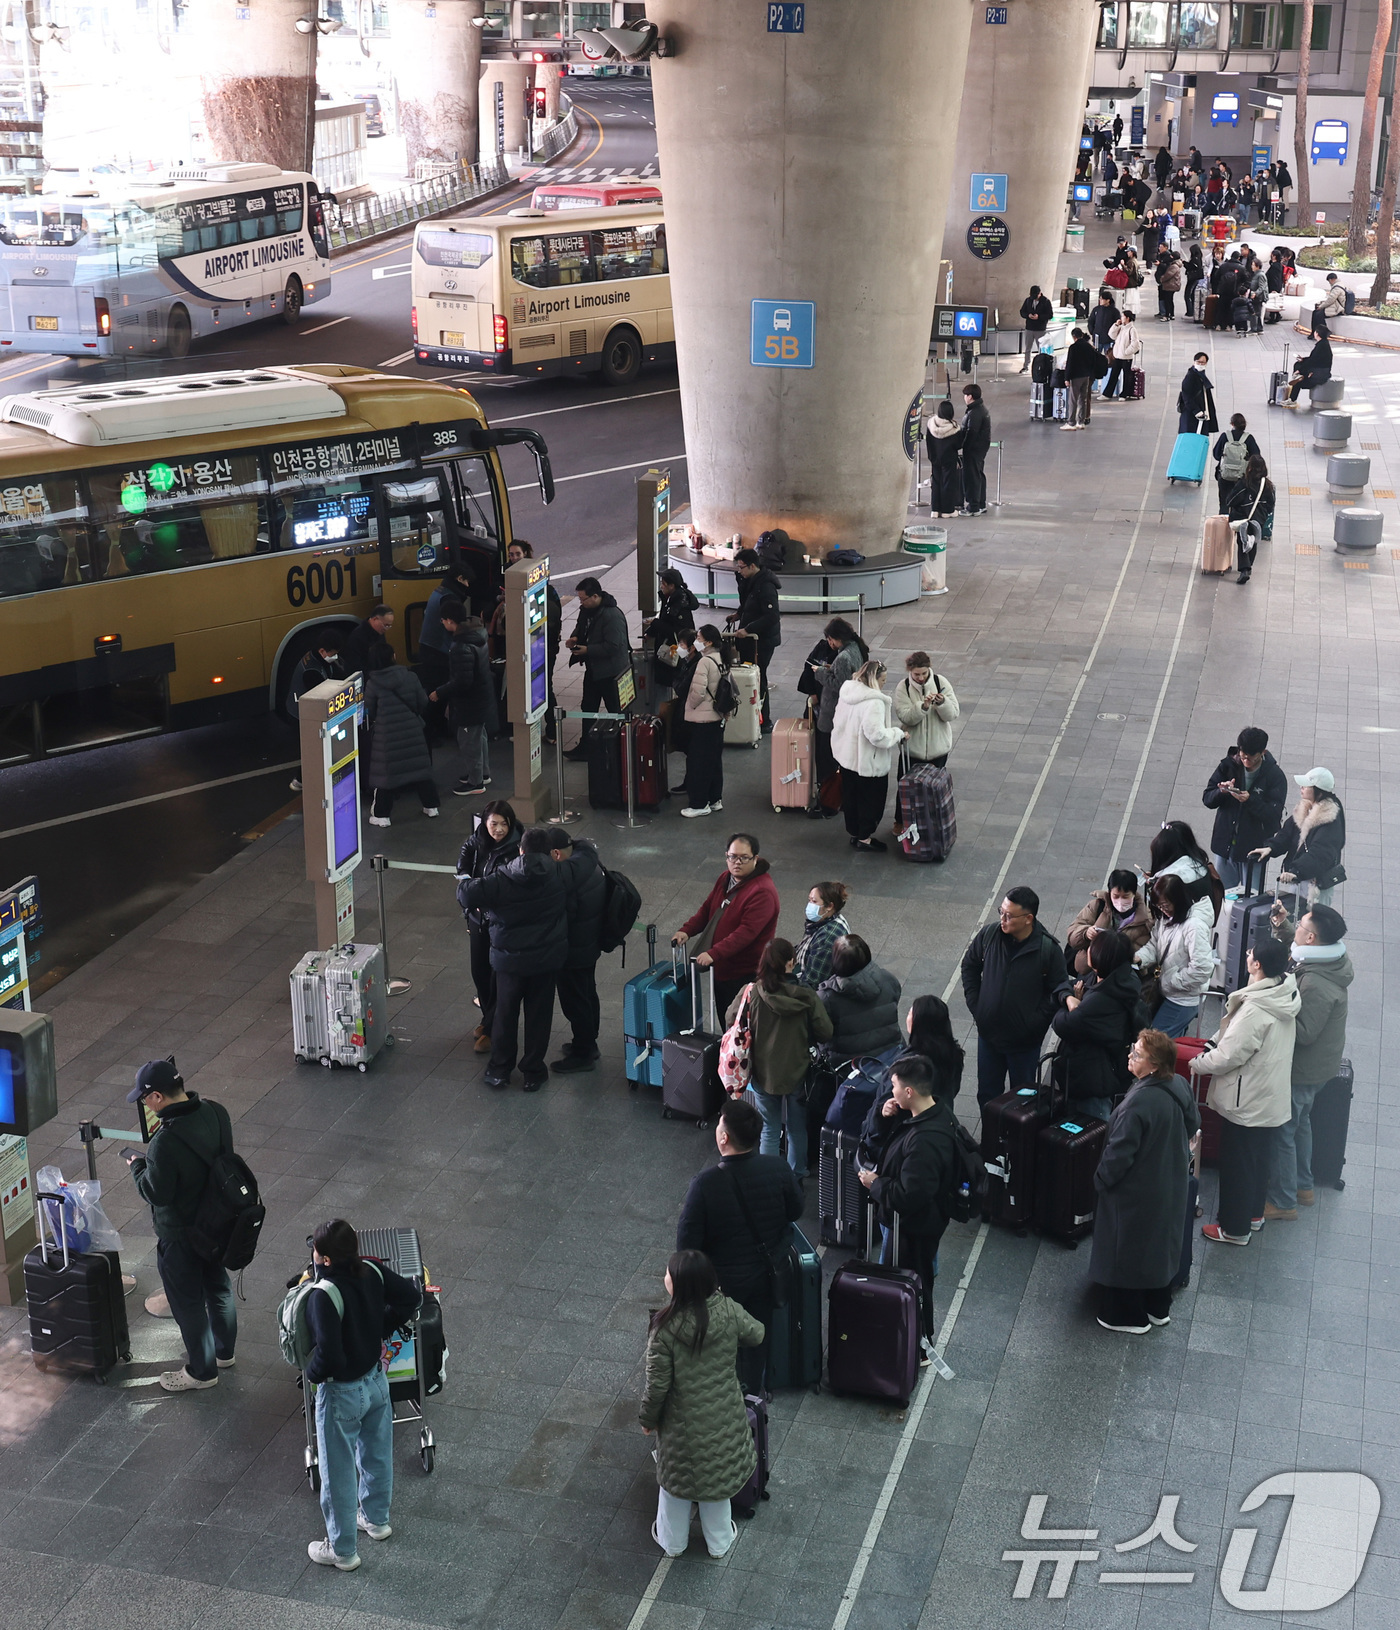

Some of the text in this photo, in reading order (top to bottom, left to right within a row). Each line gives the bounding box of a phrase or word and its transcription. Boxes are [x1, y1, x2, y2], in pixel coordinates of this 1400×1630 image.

[274, 187, 301, 207] 인천공항
[977, 193, 999, 207] 6A
[1076, 188, 1089, 198] 6B
[2, 252, 78, 261] AIRPORT LIMOUSINE
[204, 238, 305, 279] AIRPORT LIMOUSINE
[436, 300, 468, 311] 공항리무진
[529, 290, 631, 316] Airport Limousine
[958, 316, 978, 332] 6A
[765, 335, 800, 359] 5B
[437, 353, 470, 364] 공항리무진
[432, 430, 457, 446] 385
[273, 436, 401, 474] 인천공항 제1,2터미널
[286, 472, 318, 482] INCHEON
[319, 468, 348, 479] AIRPORT
[350, 463, 382, 474] TERMINAL
[0, 484, 49, 513] 울역
[193, 485, 223, 497] YONGSAN
[286, 557, 357, 607] 6001
[335, 686, 354, 712] 5B-2
